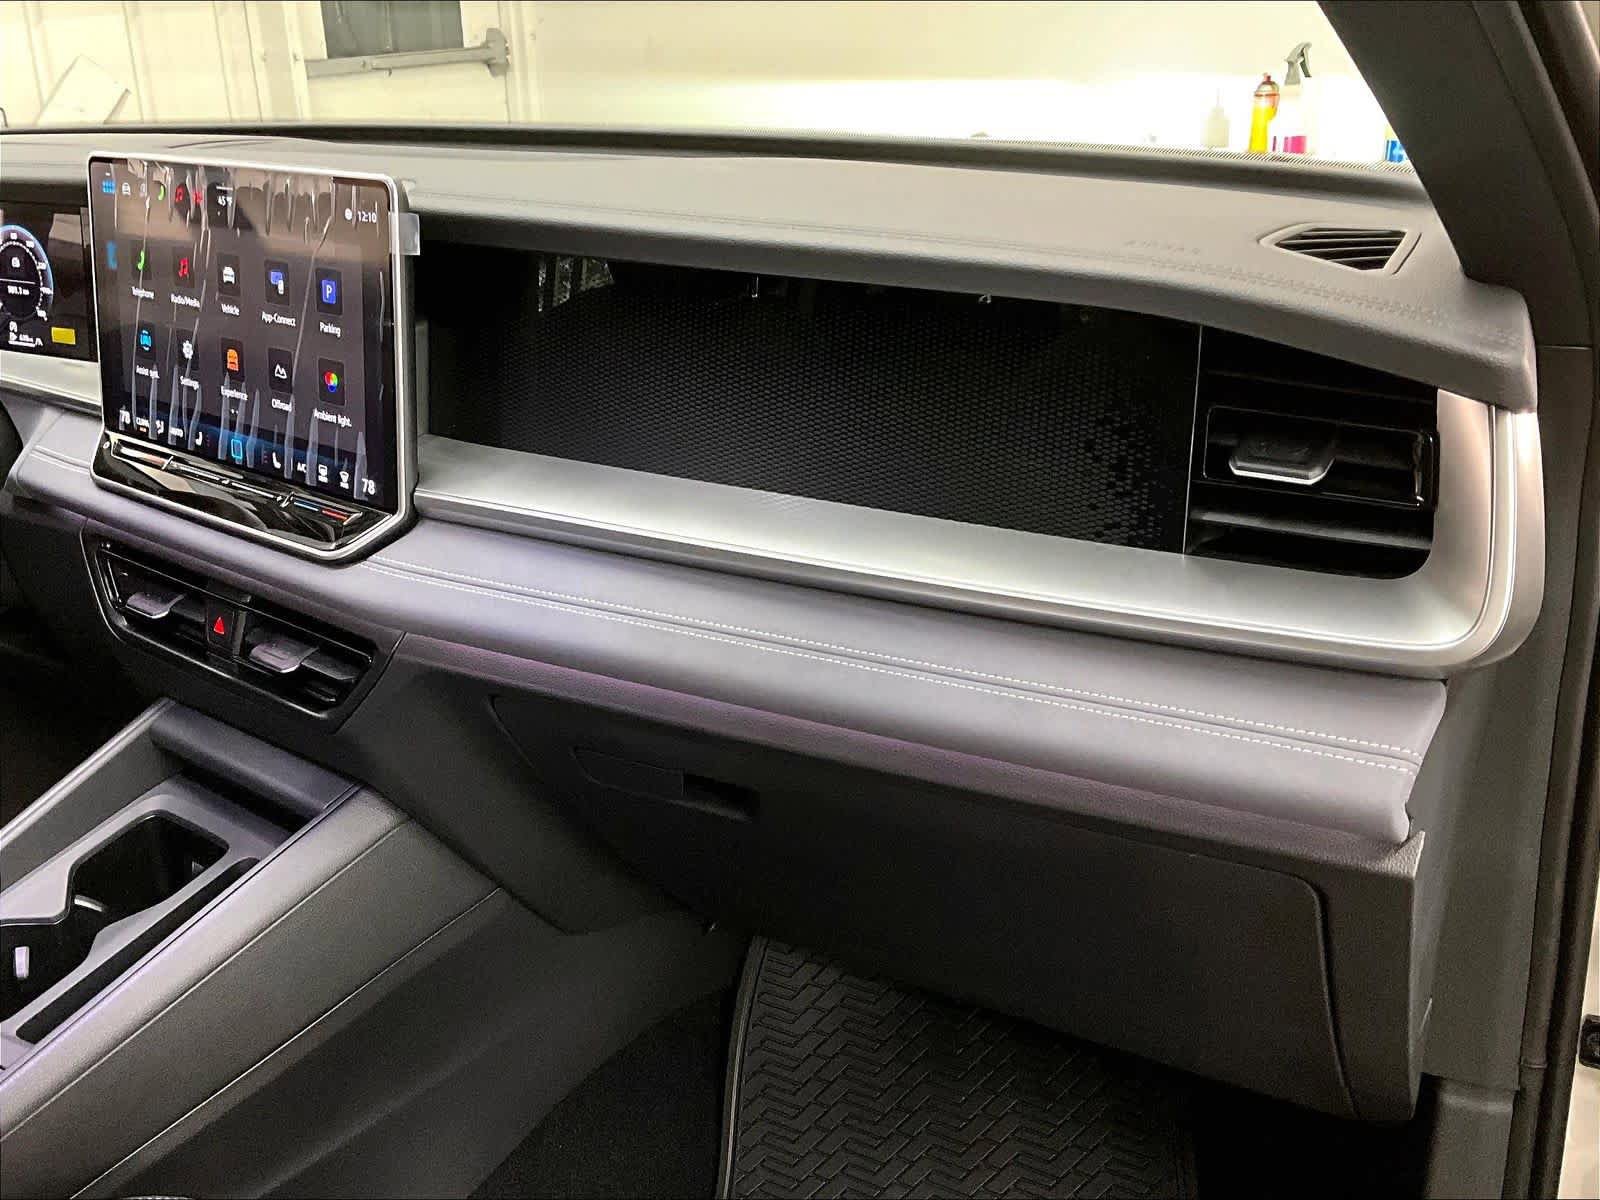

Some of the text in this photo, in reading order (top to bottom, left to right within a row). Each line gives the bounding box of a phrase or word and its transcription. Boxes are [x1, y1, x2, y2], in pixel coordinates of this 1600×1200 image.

[357, 210, 377, 223] 12:10
[221, 303, 240, 316] Vehicle
[261, 311, 296, 327] App-Connect
[319, 321, 341, 338] Parking
[313, 407, 337, 424] Ambient
[362, 477, 376, 495] 78
